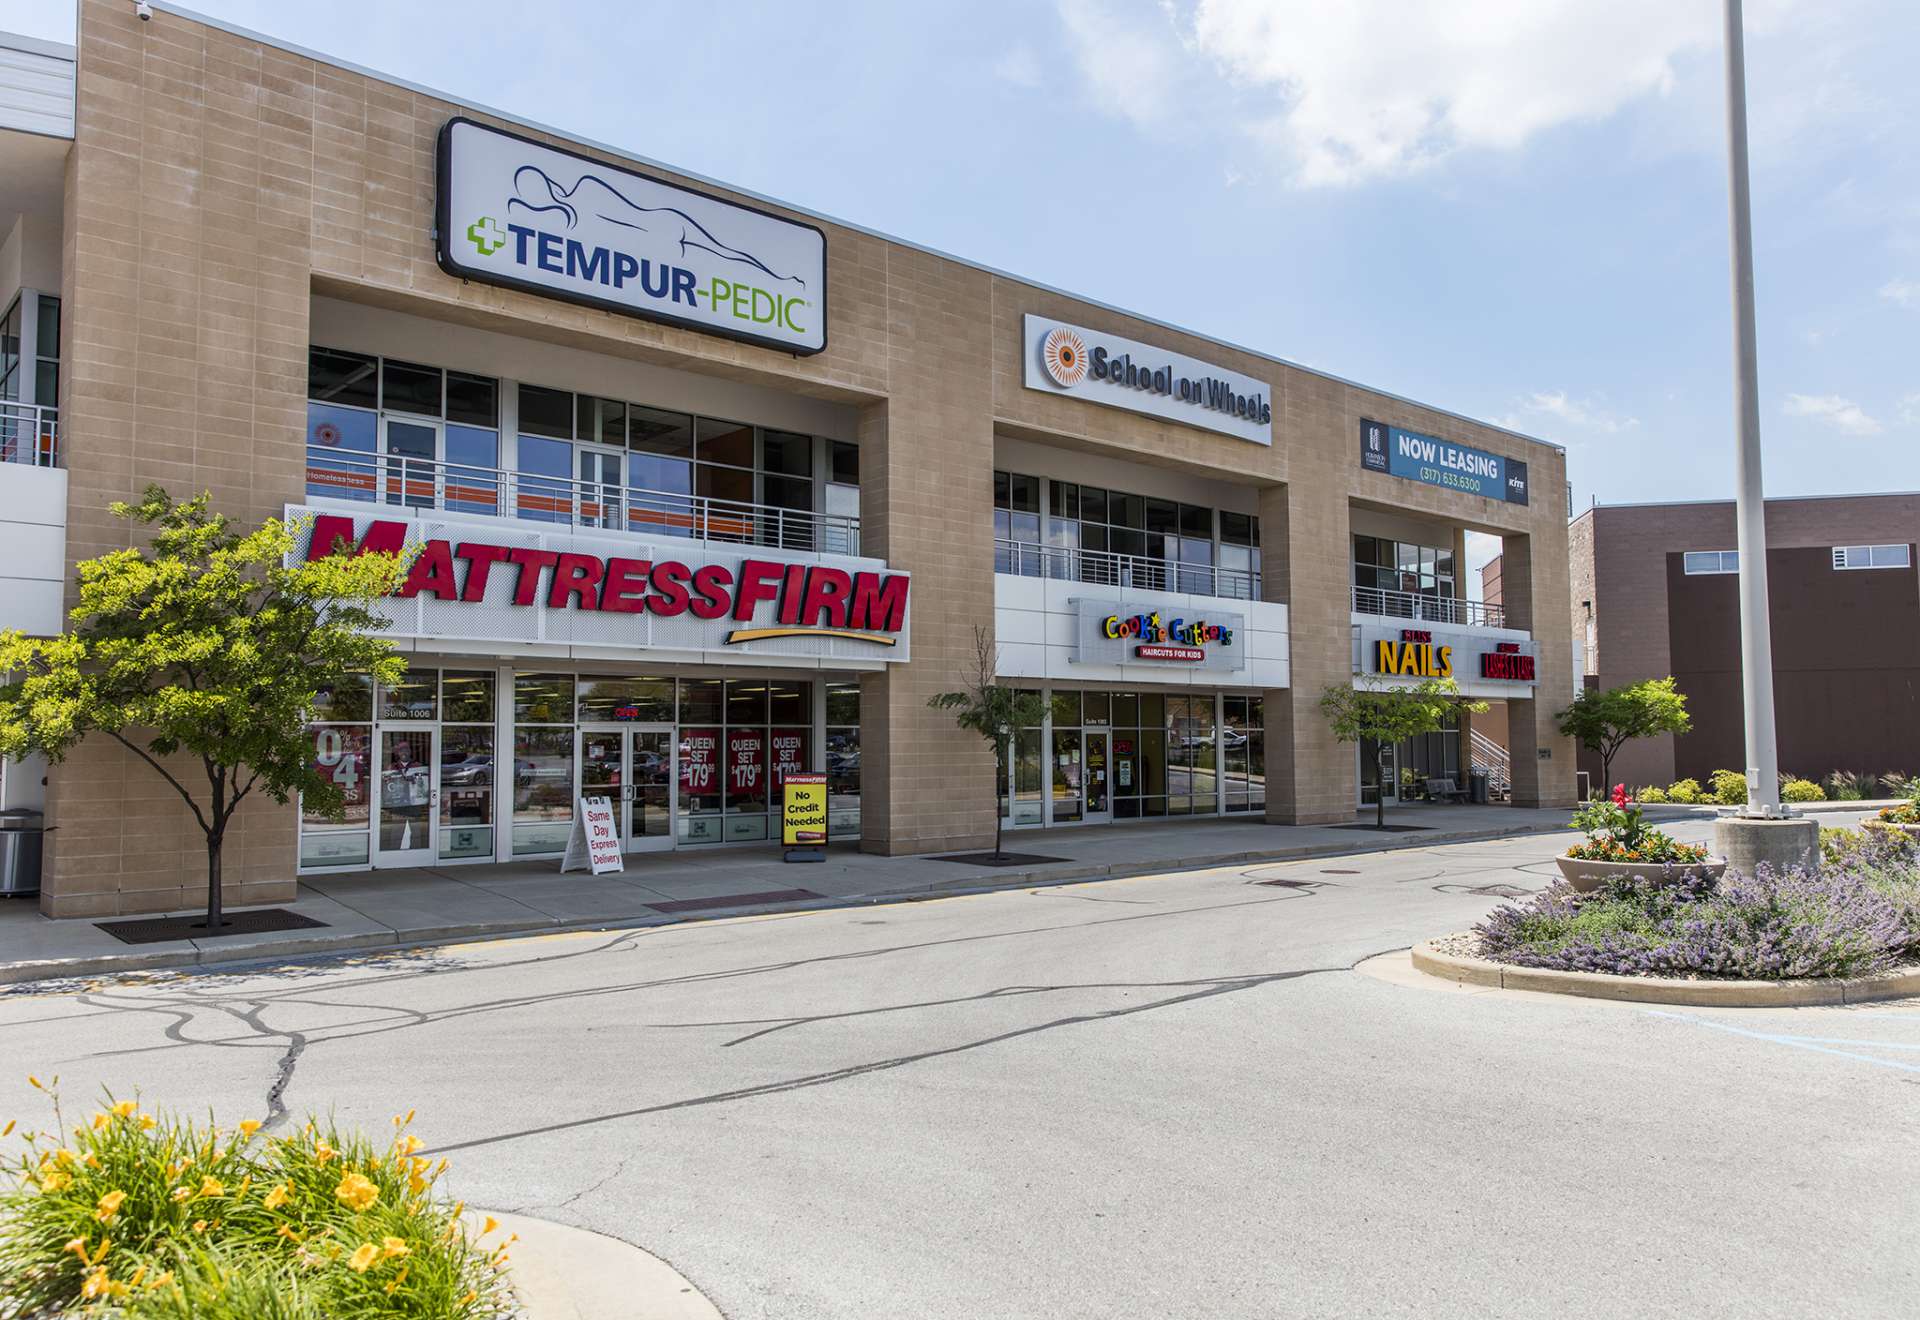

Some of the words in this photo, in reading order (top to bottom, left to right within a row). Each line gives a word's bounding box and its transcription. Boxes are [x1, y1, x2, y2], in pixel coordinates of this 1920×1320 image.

[1089, 346, 1172, 396] School
[1178, 377, 1202, 404] on
[1205, 377, 1271, 425] Wheels
[1399, 435, 1436, 463] NOW
[1440, 446, 1498, 479] LEASING
[1419, 466, 1441, 485] (317)
[1102, 611, 1168, 643] Cookie
[1169, 618, 1233, 647] Cutters
[1142, 648, 1173, 658] HAIRCUTS
[1174, 649, 1187, 659] FOR
[1187, 650, 1202, 660] KIDS
[1376, 640, 1453, 678] NAILS
[384, 709, 408, 718] Suite
[410, 710, 431, 719] 1006
[684, 737, 715, 750] QUEEN
[731, 739, 760, 751] QUEEN
[773, 737, 801, 749] QUEEN
[690, 750, 709, 762] SET
[737, 752, 755, 764] SET
[779, 750, 795, 761] SET
[795, 791, 810, 801] No
[788, 803, 820, 814] Credit
[587, 810, 610, 823] Same
[785, 815, 825, 827] Needed
[593, 825, 609, 838] Day
[590, 840, 617, 851] Express
[593, 854, 620, 866] Delivery
